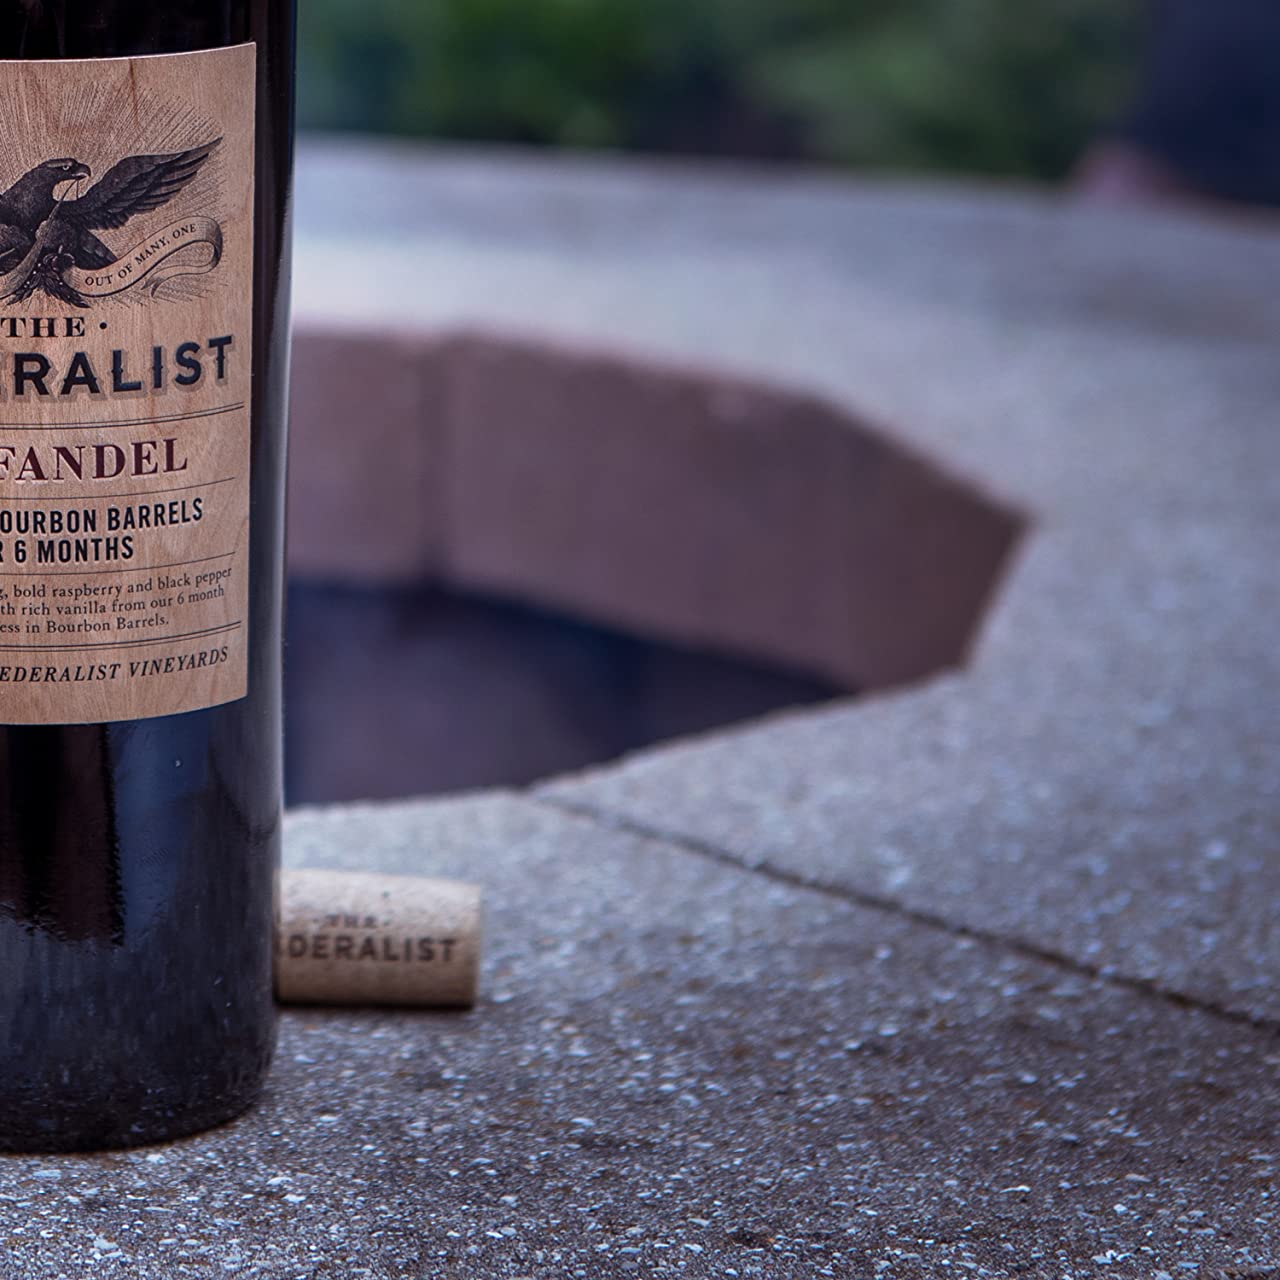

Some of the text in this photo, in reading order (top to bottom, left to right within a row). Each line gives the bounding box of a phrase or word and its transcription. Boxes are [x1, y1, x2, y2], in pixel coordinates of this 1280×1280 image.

[84, 223, 197, 287] OUT OF MANY, ONE
[0, 316, 86, 338] THE
[106, 497, 203, 531] BARRELS
[14, 537, 27, 563] 6
[37, 535, 134, 563] MONTHS
[13, 583, 46, 598] bold
[52, 583, 122, 600] raspberry
[127, 578, 153, 593] and
[157, 573, 191, 590] black
[195, 568, 232, 587] pepper
[21, 602, 51, 615] rich
[56, 602, 106, 615] vanilla
[111, 599, 146, 612] from
[150, 596, 174, 609] our
[176, 593, 185, 606] 6
[188, 584, 225, 604] month
[25, 621, 41, 634] in
[46, 619, 111, 634] Bourbon
[116, 614, 170, 630] Barrels.
[128, 645, 229, 678] VINEYARDS
[287, 934, 457, 962] DERALIST
